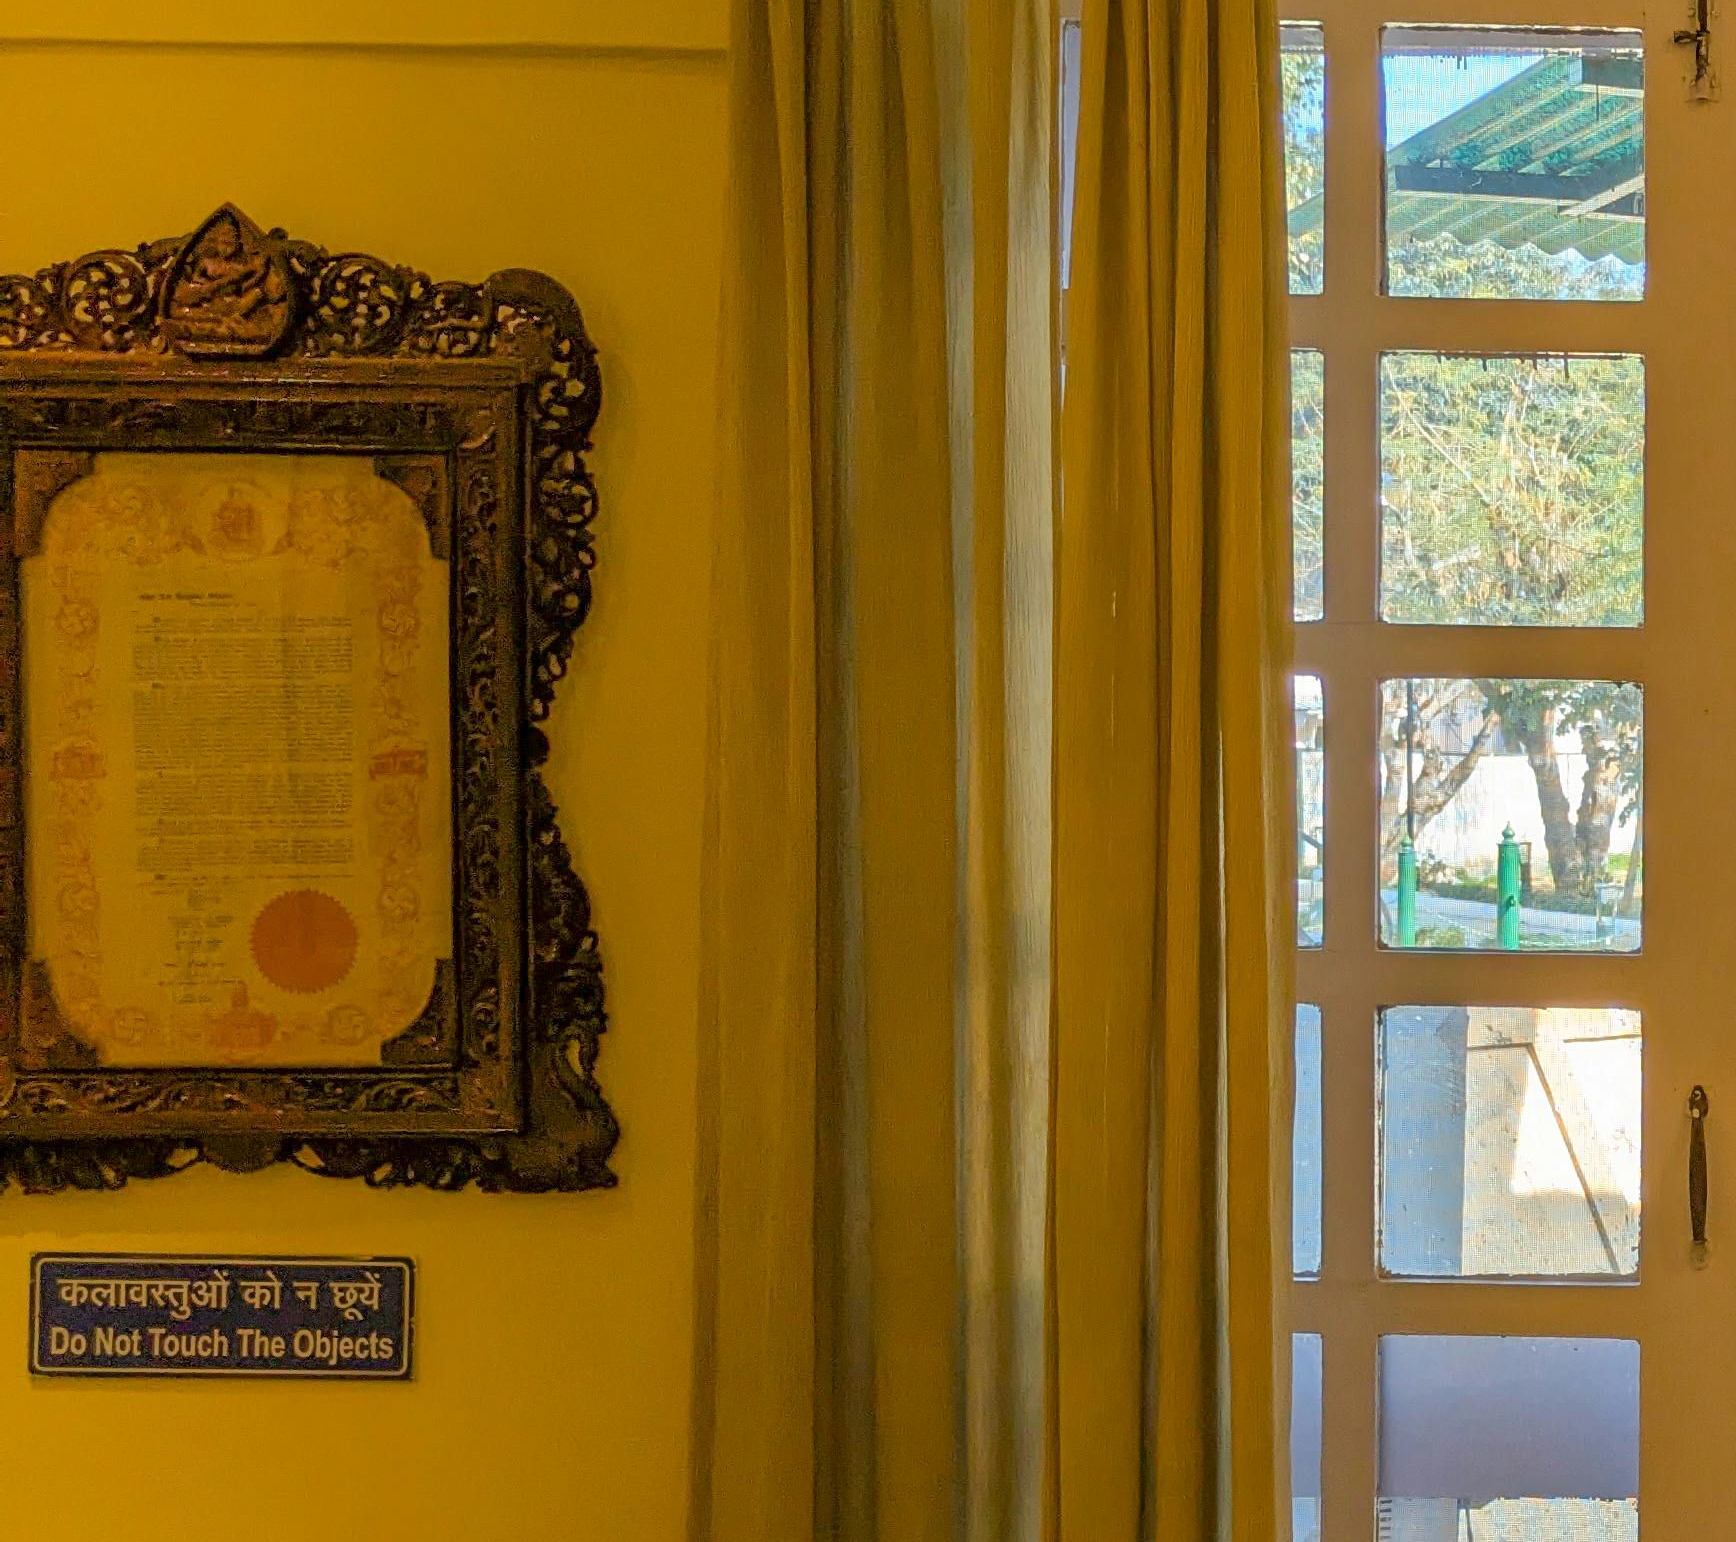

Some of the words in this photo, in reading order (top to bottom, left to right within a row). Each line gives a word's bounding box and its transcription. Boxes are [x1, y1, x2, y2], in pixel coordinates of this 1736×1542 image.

[57, 1270, 229, 1319] कलावस्तुओं
[241, 1271, 281, 1309] को
[294, 1279, 319, 1309] न
[329, 1272, 382, 1320] छूयें
[51, 1327, 86, 1355] Do
[96, 1328, 141, 1356] Not
[148, 1328, 229, 1357] Touch
[237, 1329, 285, 1357] The
[294, 1329, 393, 1364] Objects
